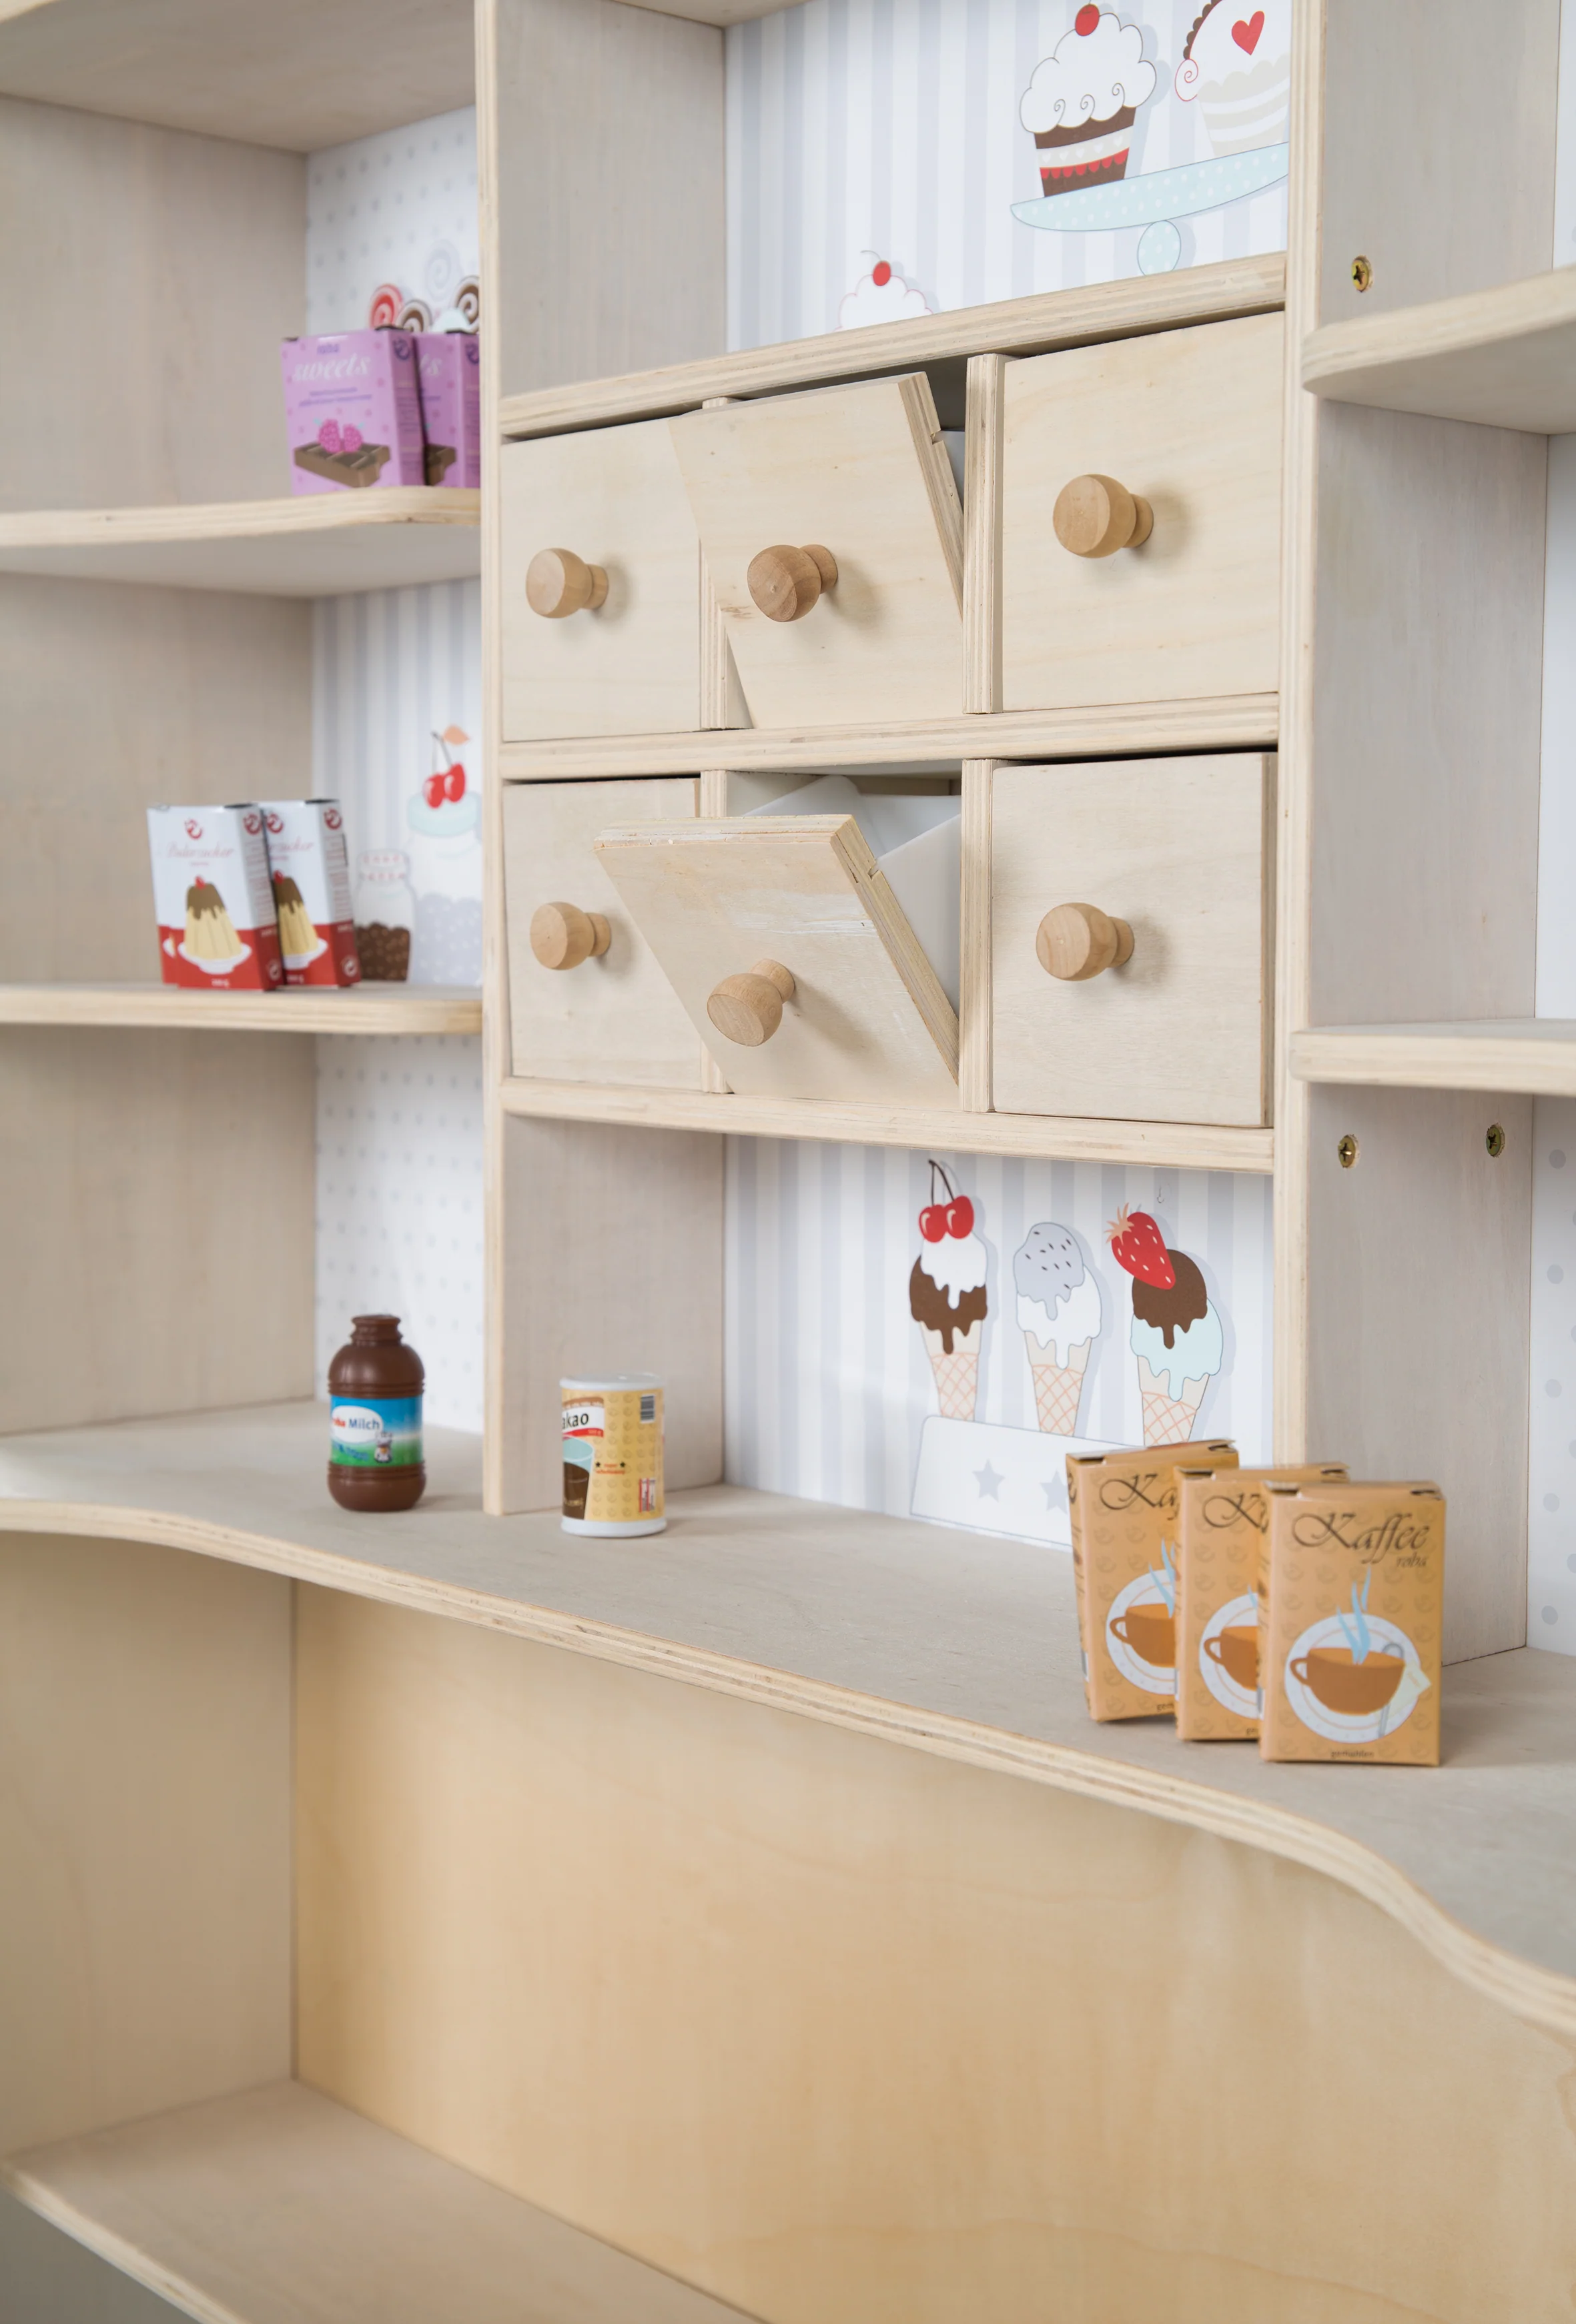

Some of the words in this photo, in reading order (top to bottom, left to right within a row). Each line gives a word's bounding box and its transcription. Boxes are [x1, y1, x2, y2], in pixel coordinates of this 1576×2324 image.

[292, 352, 372, 382] sweets
[349, 1417, 380, 1431] Milch
[1290, 1512, 1431, 1565] Kaffee
